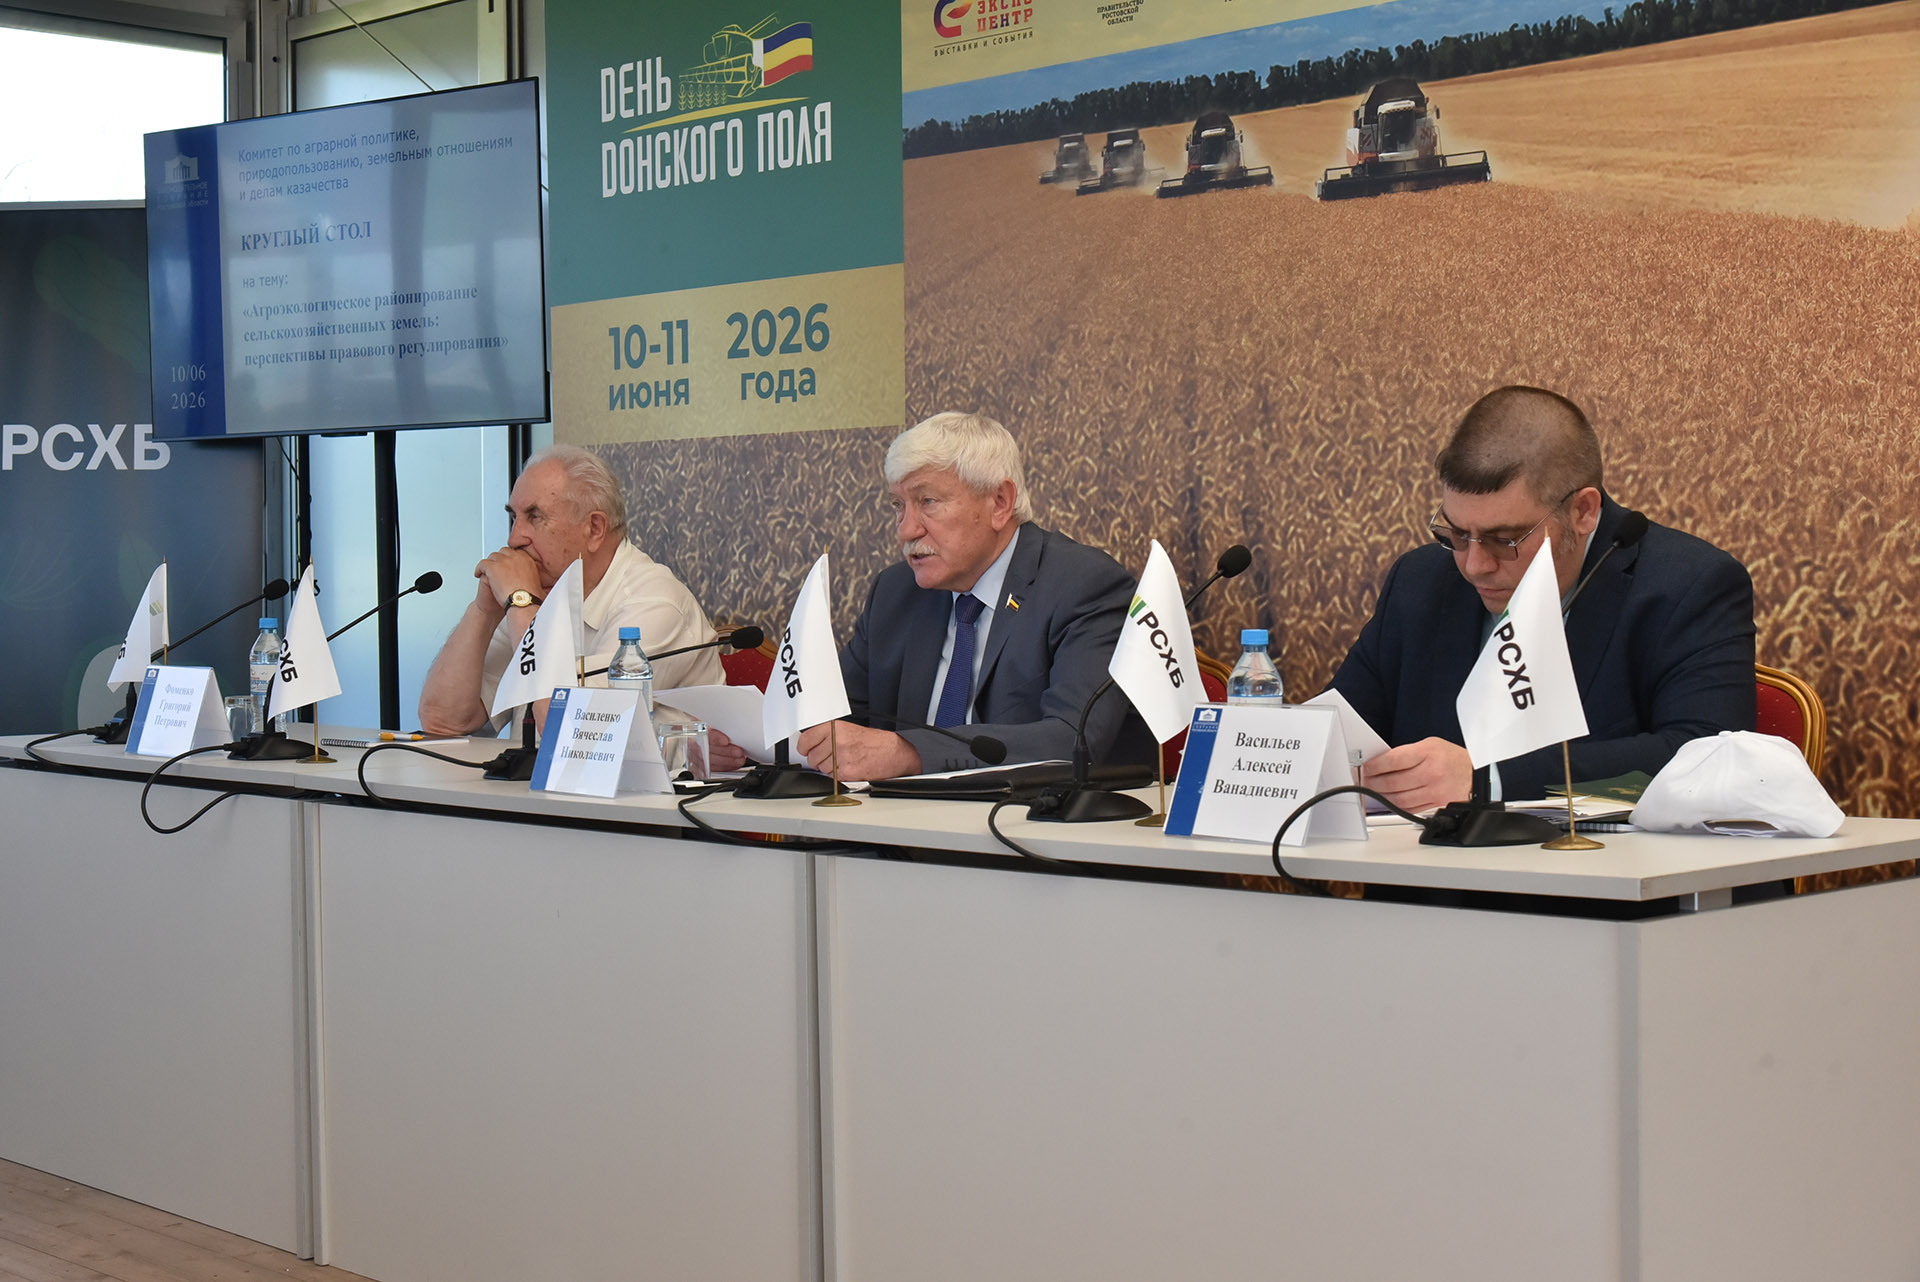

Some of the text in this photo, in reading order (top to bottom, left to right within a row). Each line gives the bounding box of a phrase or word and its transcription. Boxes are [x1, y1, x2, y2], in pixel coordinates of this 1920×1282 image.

[977, 8, 1033, 32] ЦЕНТР
[1102, 6, 1139, 19] РОСТОВСКОЙ
[1107, 15, 1134, 25] ОБЛАСТИ
[934, 42, 979, 57] ВЫСТАВКИ
[992, 31, 1033, 46] СОБЫТИЯ
[238, 128, 420, 163] Комитет по аграрной политике,
[757, 101, 832, 173] ПОЛЯ
[239, 136, 513, 184] природопользованию, земельным отношениям
[239, 177, 349, 202] и делам казачества
[241, 221, 371, 251] КРУГЛЫЙ СТОЛ
[242, 274, 289, 289] на тему:
[243, 287, 478, 320] «Агроэкологическое районирование
[243, 315, 439, 343] сельскохозяйственных земель:
[608, 303, 831, 370] 10-11 2026
[244, 336, 509, 369] перспективы правового регулирования»
[172, 363, 206, 382] 10/06
[171, 391, 206, 410] 2026
[608, 366, 817, 411] июня года
[1, 423, 172, 471] РСХБ
[279, 638, 299, 683] СХБ
[1136, 610, 1185, 689] РСХБ
[781, 627, 803, 699] РСХБ
[1493, 621, 1536, 710] РСХБ
[159, 699, 192, 714] Григорий
[574, 707, 621, 723] Василенко
[154, 714, 188, 729] Петрович
[571, 727, 614, 743] Вячеслав
[1234, 731, 1301, 751] Васильев
[560, 745, 616, 762] Николаевич
[1231, 756, 1293, 775] Алексей
[1212, 778, 1299, 800] Ванадиевич
